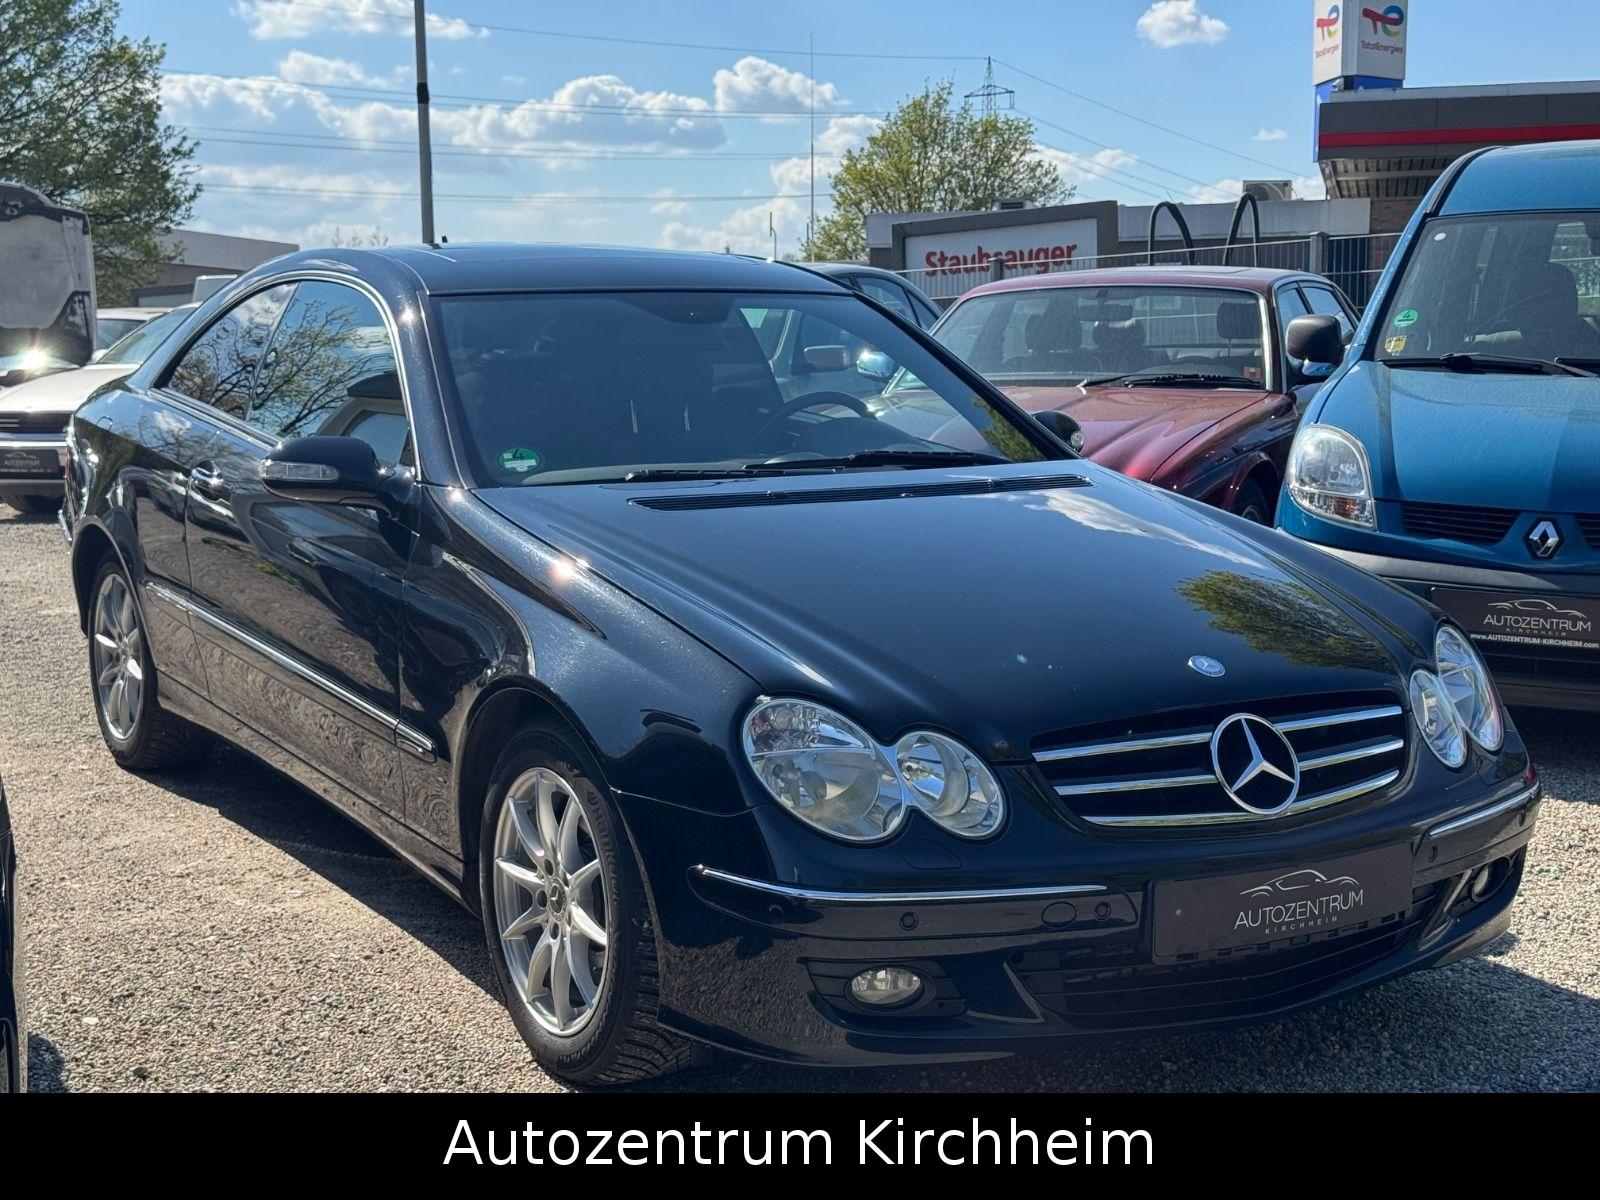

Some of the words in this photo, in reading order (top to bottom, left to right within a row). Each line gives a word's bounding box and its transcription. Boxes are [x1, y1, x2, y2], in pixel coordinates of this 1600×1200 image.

[1360, 40, 1404, 54] TotalEnergies
[1483, 614, 1592, 632] AUTOZENTRUM
[1234, 889, 1364, 930] AUTOZENTRUM
[1265, 916, 1338, 935] KIRCHHEIM
